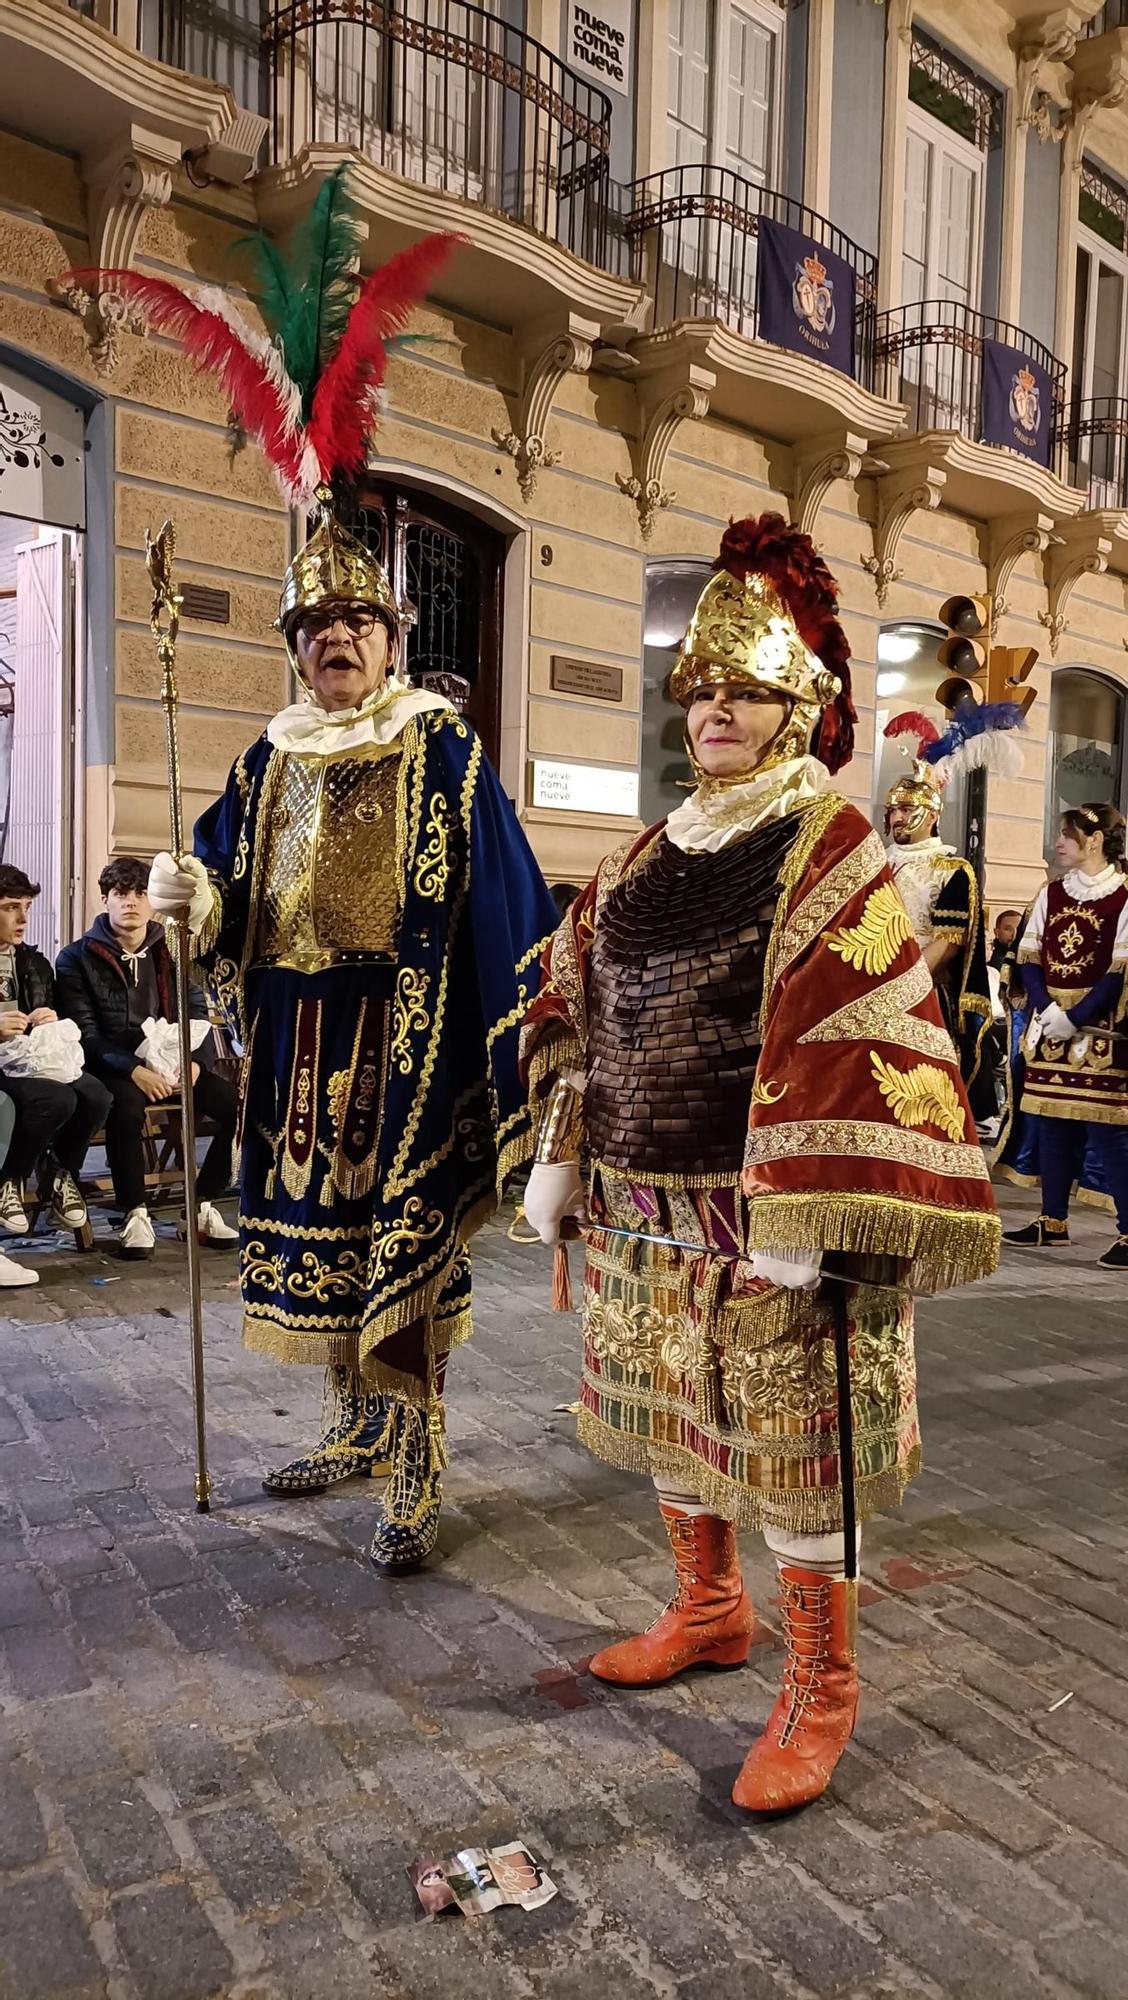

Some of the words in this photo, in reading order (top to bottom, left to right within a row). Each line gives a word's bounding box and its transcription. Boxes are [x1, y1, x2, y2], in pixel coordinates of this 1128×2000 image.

[574, 5, 625, 48] nueve
[574, 25, 622, 65] coma
[573, 41, 624, 82] nueve
[541, 544, 553, 567] 9
[540, 780, 568, 790] coma
[541, 769, 571, 781] nueve
[540, 790, 571, 801] nueve
